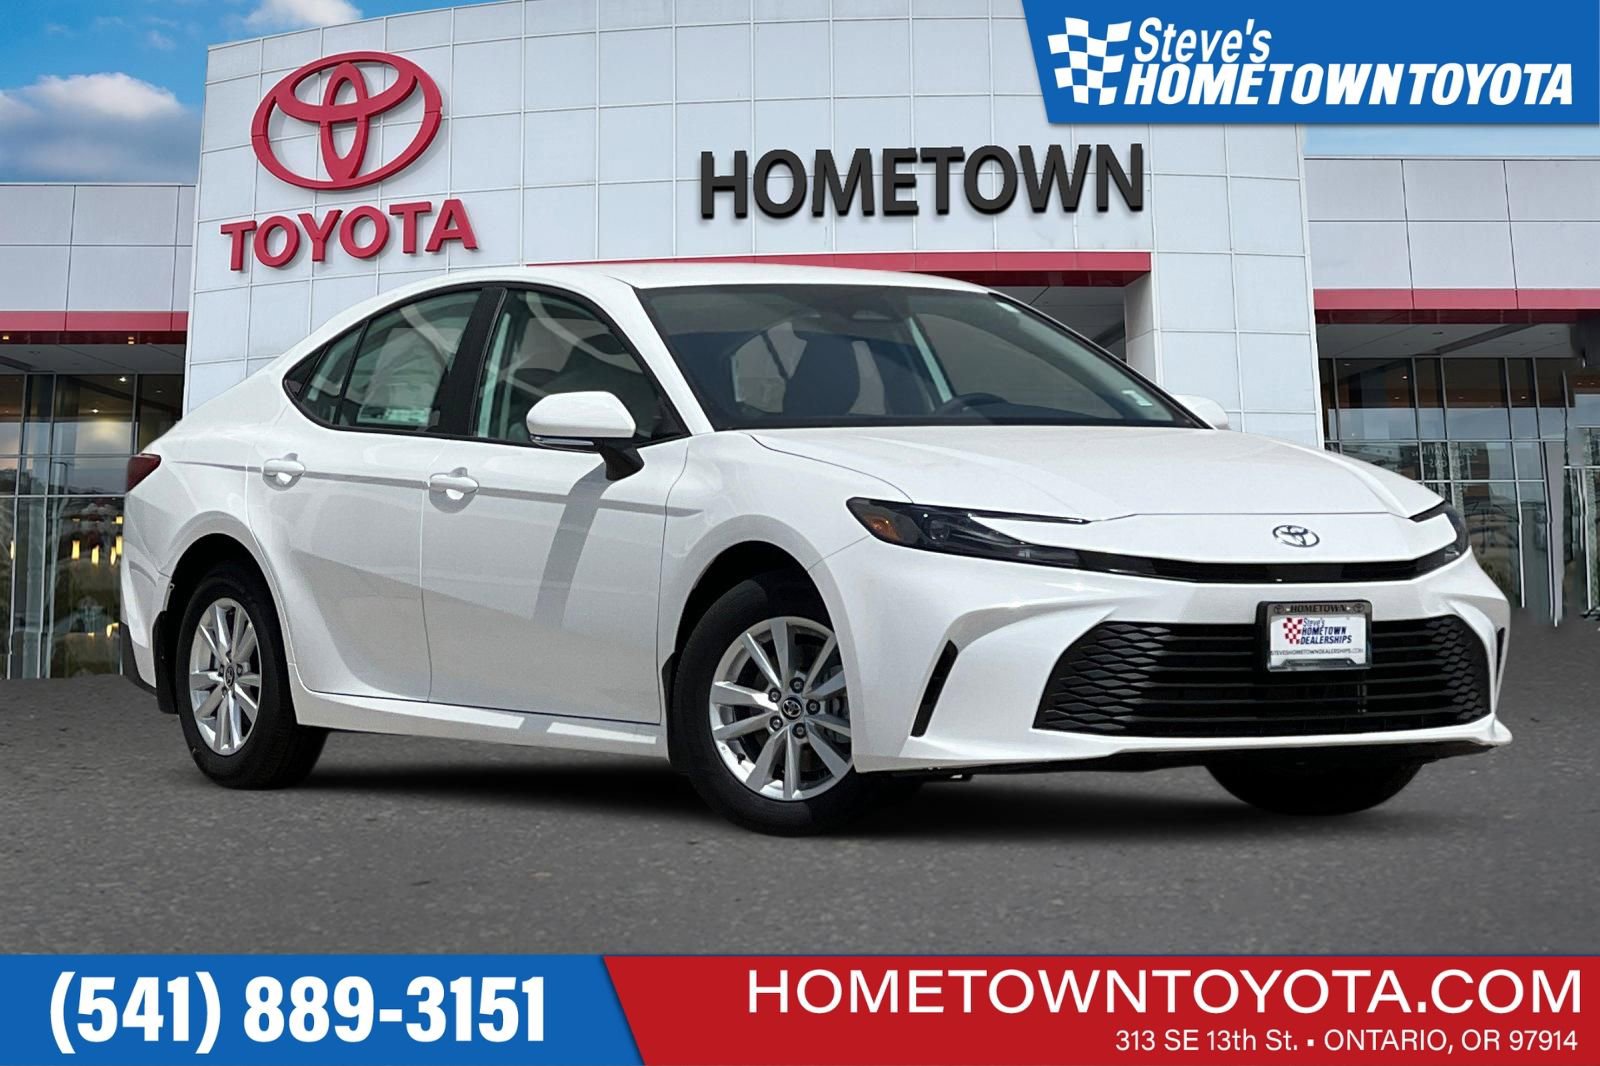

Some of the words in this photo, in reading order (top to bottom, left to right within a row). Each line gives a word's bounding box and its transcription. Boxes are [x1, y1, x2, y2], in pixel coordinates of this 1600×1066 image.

[699, 143, 1145, 220] HOMETOWN
[220, 198, 478, 271] TOYOTA
[1289, 604, 1347, 613] HOMETOWN
[1303, 617, 1325, 628] Steve's
[1301, 626, 1347, 636] HOMETOWN
[1300, 635, 1352, 645] DEALERSHIPS
